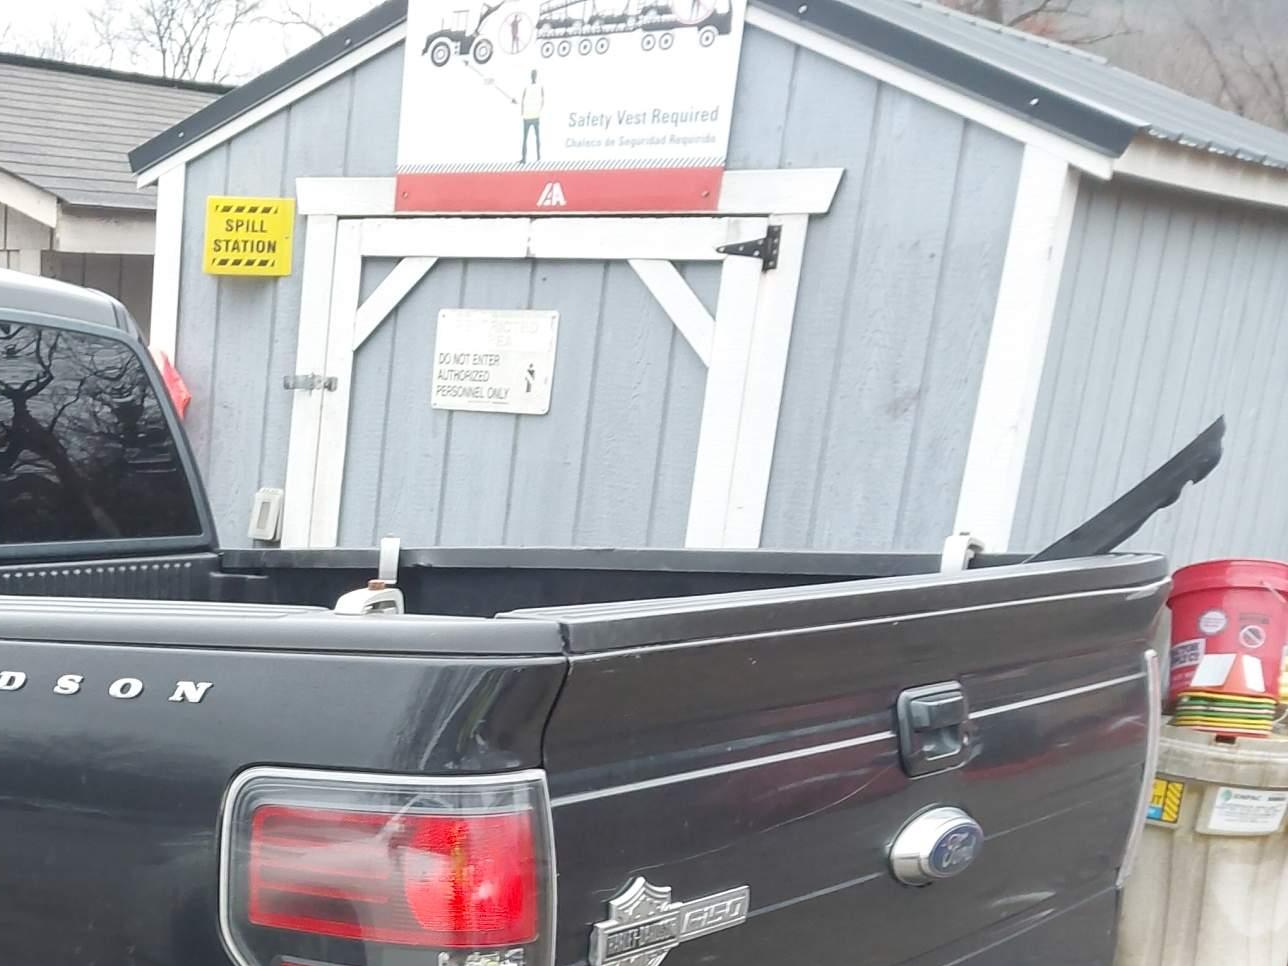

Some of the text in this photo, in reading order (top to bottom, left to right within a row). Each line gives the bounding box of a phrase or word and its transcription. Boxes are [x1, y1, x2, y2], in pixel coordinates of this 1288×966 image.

[568, 105, 720, 129] Safety Vest Required
[225, 218, 268, 233] SPILL
[213, 239, 277, 253] STATION
[438, 353, 500, 366] DO NOT ENTER
[437, 369, 490, 382] AUTHORIZED
[436, 385, 511, 399] PERSONNEL ONLY
